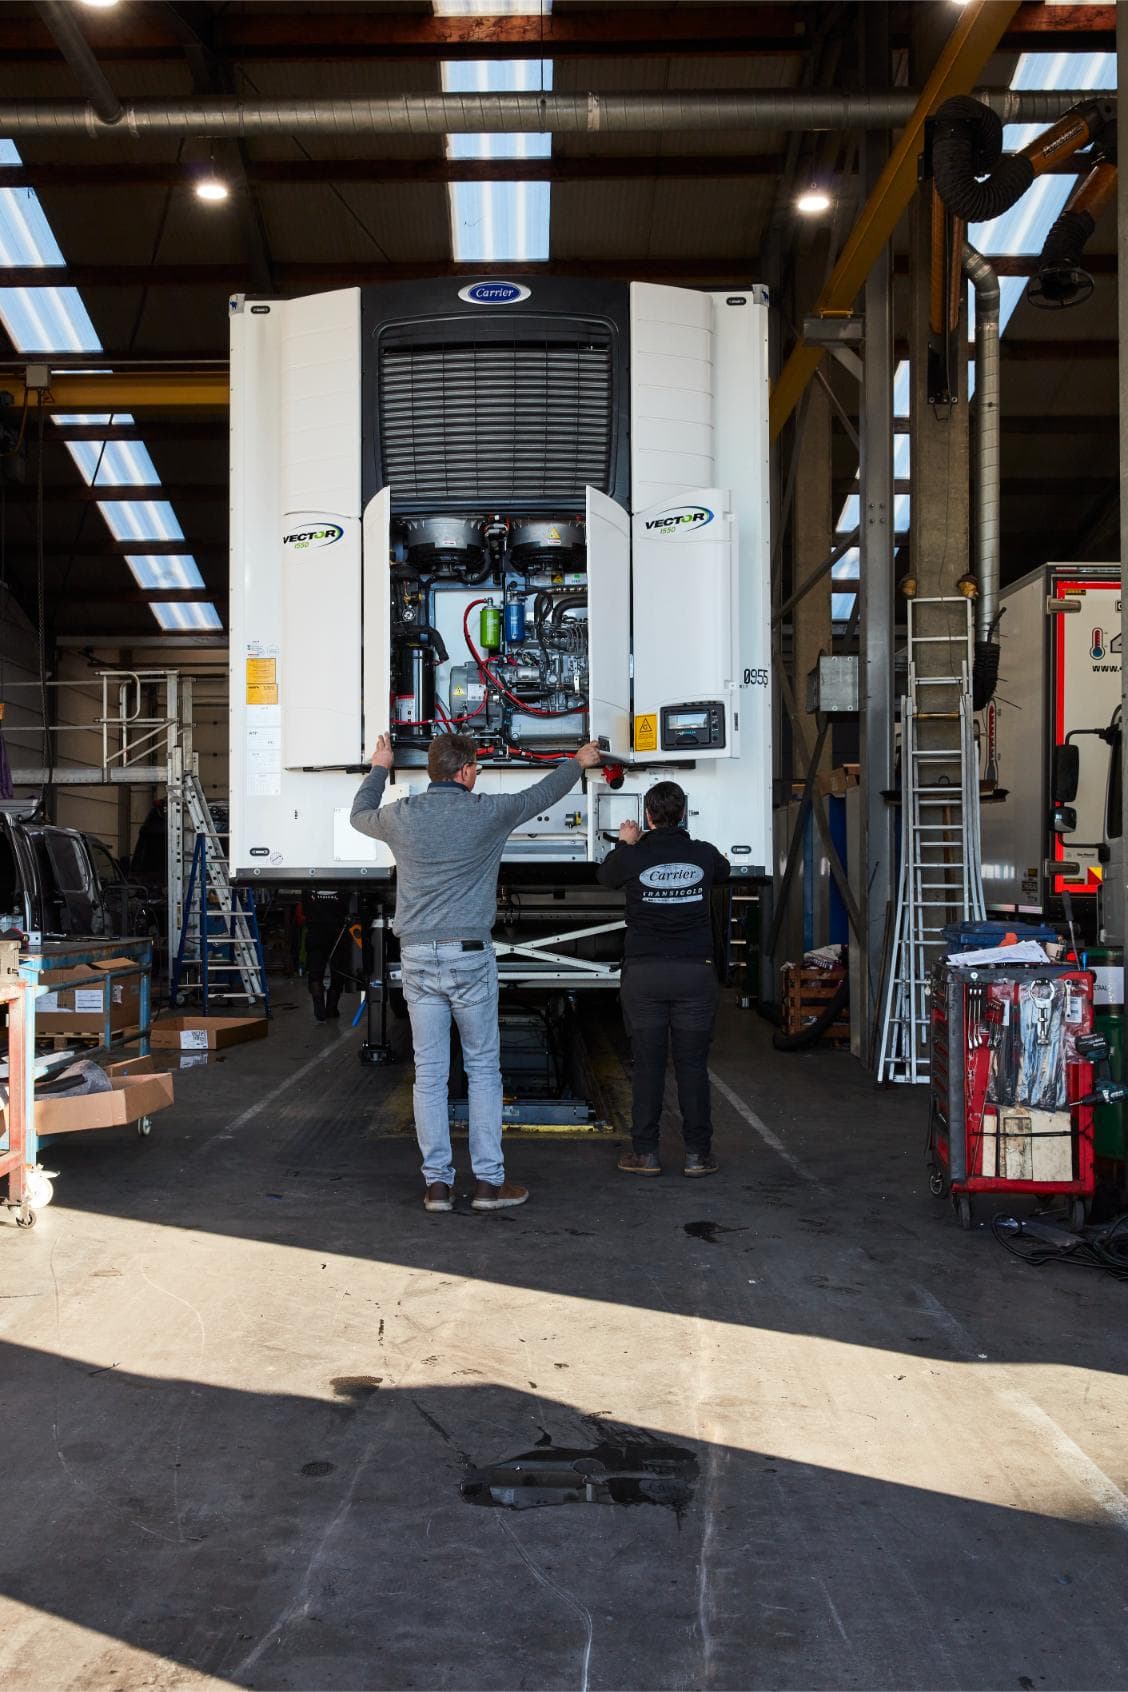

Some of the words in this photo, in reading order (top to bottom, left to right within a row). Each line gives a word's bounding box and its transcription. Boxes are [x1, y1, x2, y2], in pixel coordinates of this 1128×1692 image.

[476, 287, 514, 298] Carrier
[645, 512, 705, 530] VECTOR
[282, 529, 337, 544] VECTOR
[743, 668, 769, 686] 0955
[649, 869, 697, 881] Carrier
